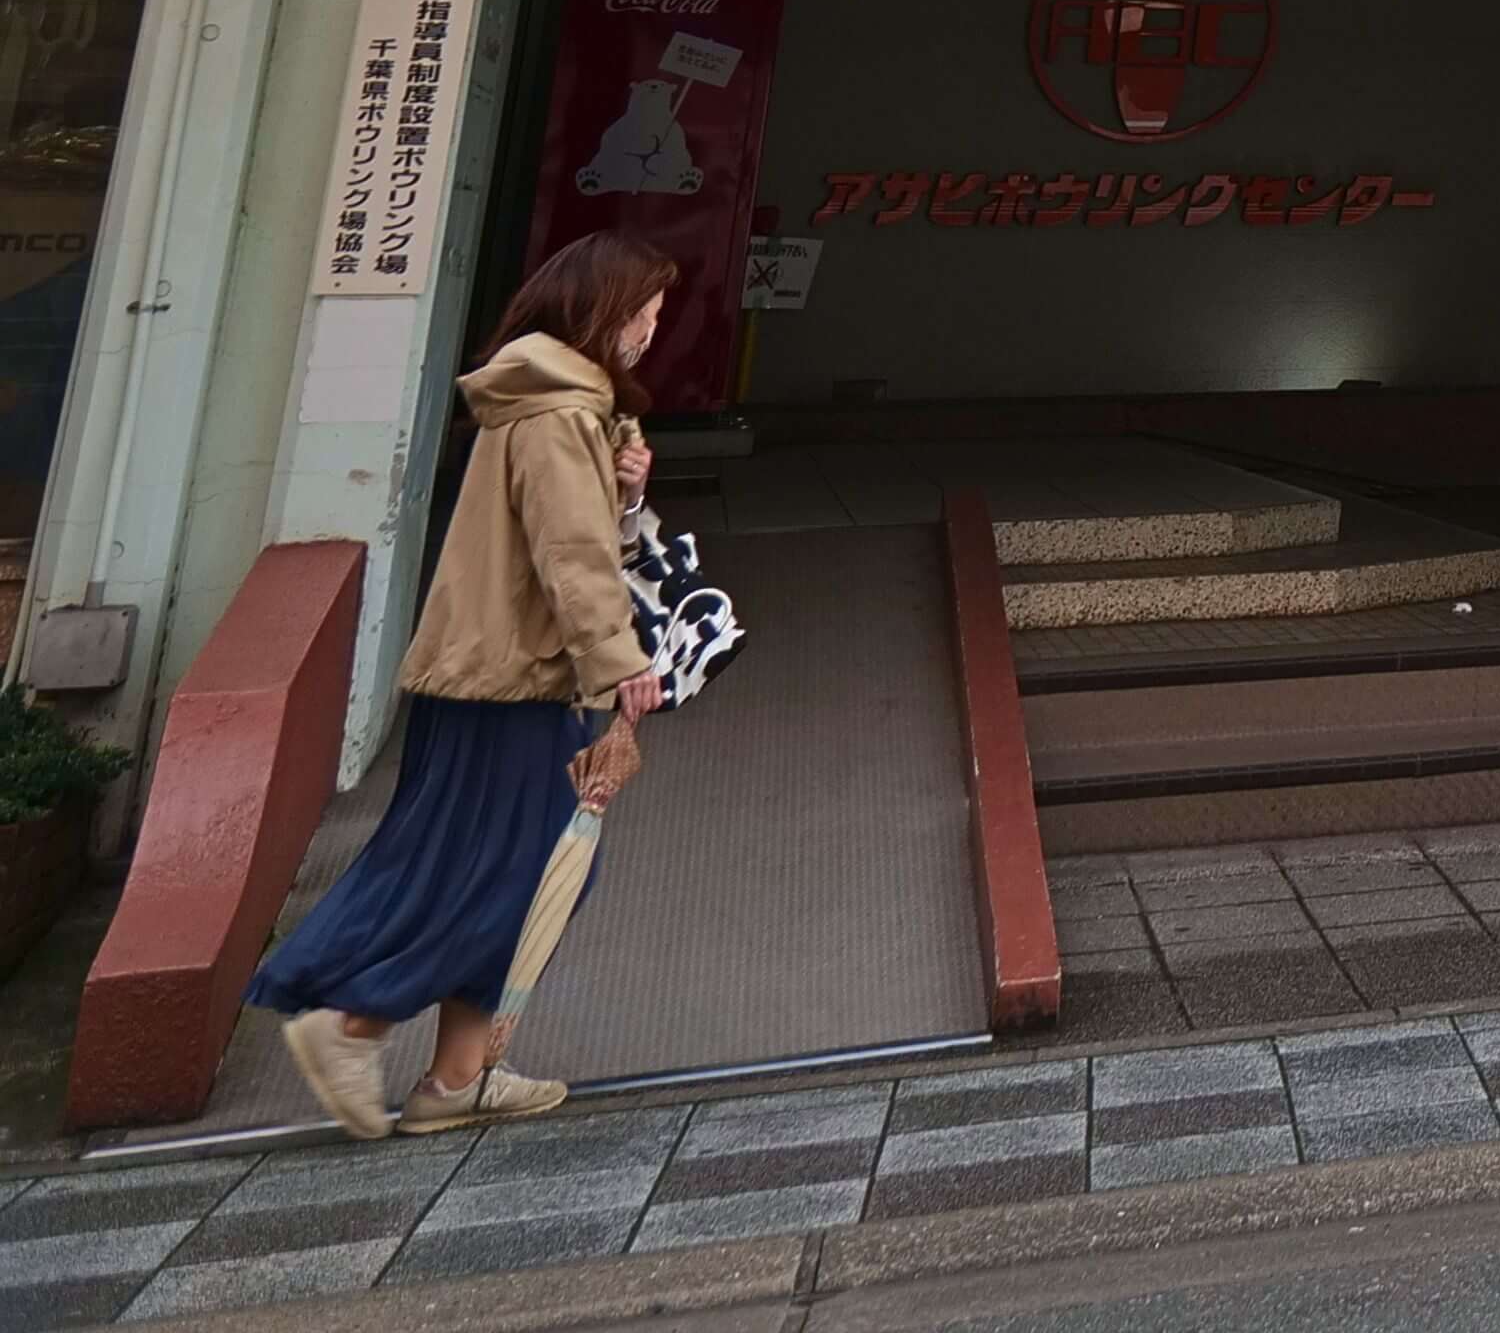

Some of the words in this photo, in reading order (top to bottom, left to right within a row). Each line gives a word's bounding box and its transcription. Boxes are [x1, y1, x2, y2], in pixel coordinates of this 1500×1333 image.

[331, 38, 397, 274] 千葉県ボウリング場協会
[808, 172, 1436, 229] アサヒボウリングセンター
